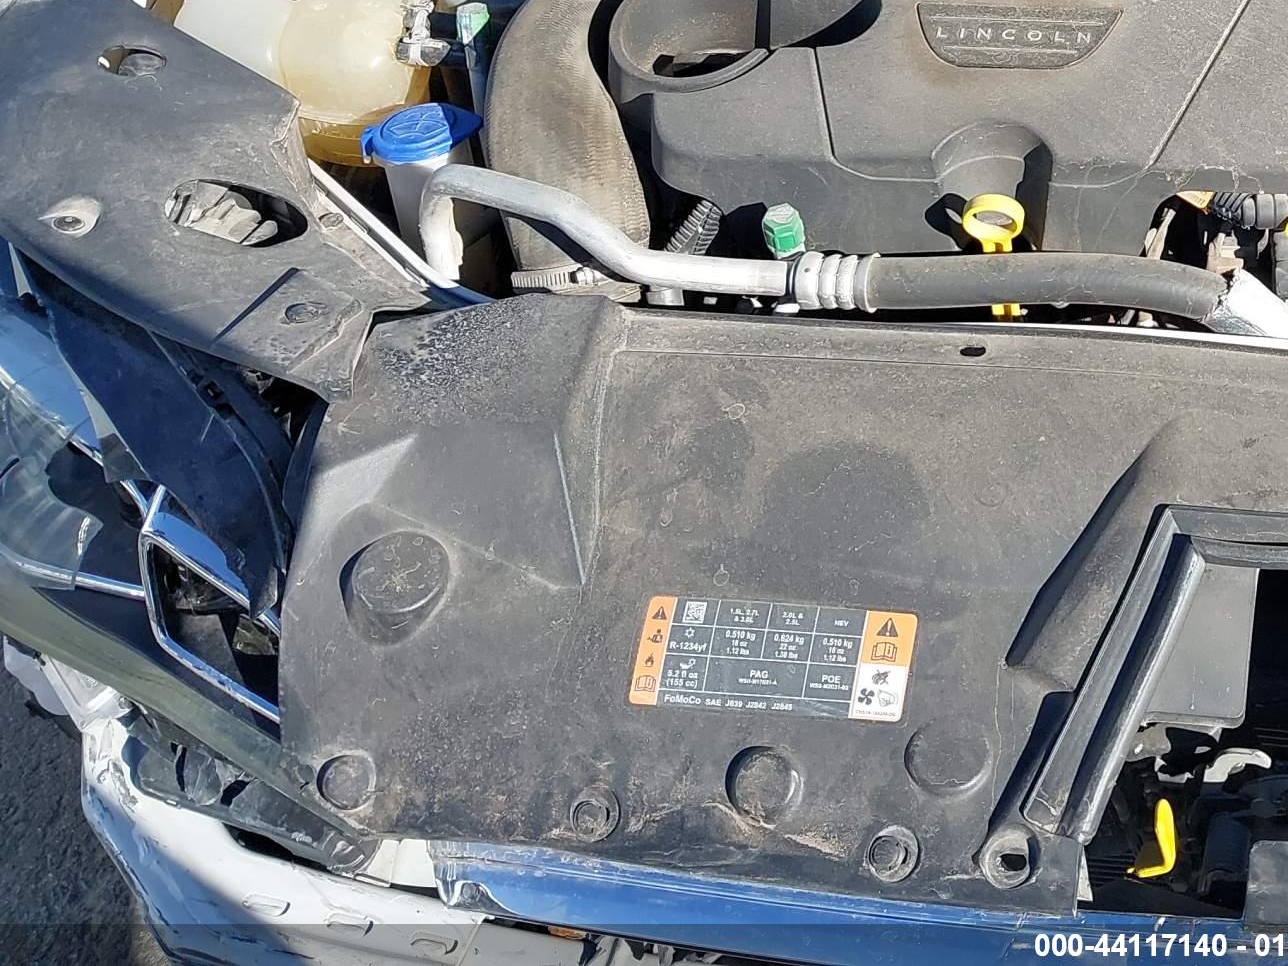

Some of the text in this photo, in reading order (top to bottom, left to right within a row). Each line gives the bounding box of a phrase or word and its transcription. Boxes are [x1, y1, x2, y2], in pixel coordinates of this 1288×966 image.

[936, 26, 1091, 44] LINCOLN
[746, 630, 756, 641] kg
[795, 634, 804, 645] kg
[669, 641, 707, 653] R-1234yf
[843, 639, 853, 649] kg
[667, 669, 698, 679] 5.2 fl oz
[750, 669, 768, 679] PAG
[821, 674, 841, 684] POE
[666, 677, 698, 689] (155 cc)
[664, 694, 701, 705] FoMoCo
[705, 698, 721, 707] SAE
